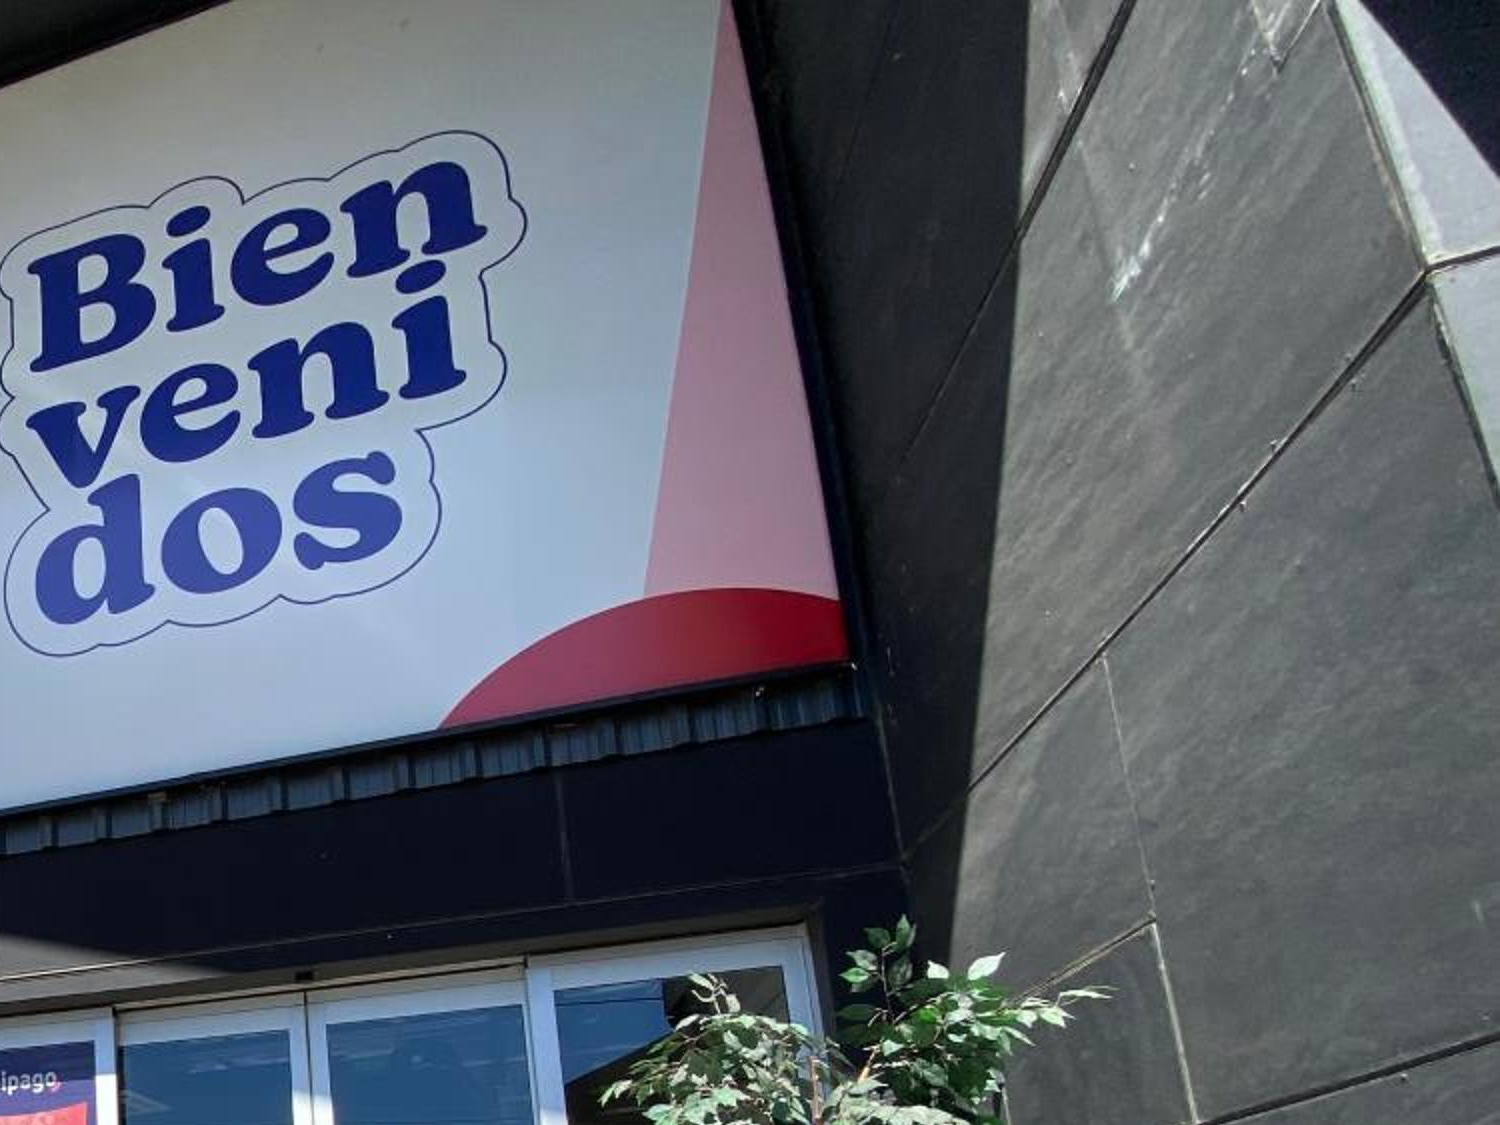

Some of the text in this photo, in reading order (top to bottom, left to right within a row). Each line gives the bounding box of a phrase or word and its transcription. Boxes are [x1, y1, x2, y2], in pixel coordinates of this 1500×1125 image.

[28, 159, 487, 373] Bien
[26, 262, 466, 488] veni
[34, 452, 404, 626] dos
